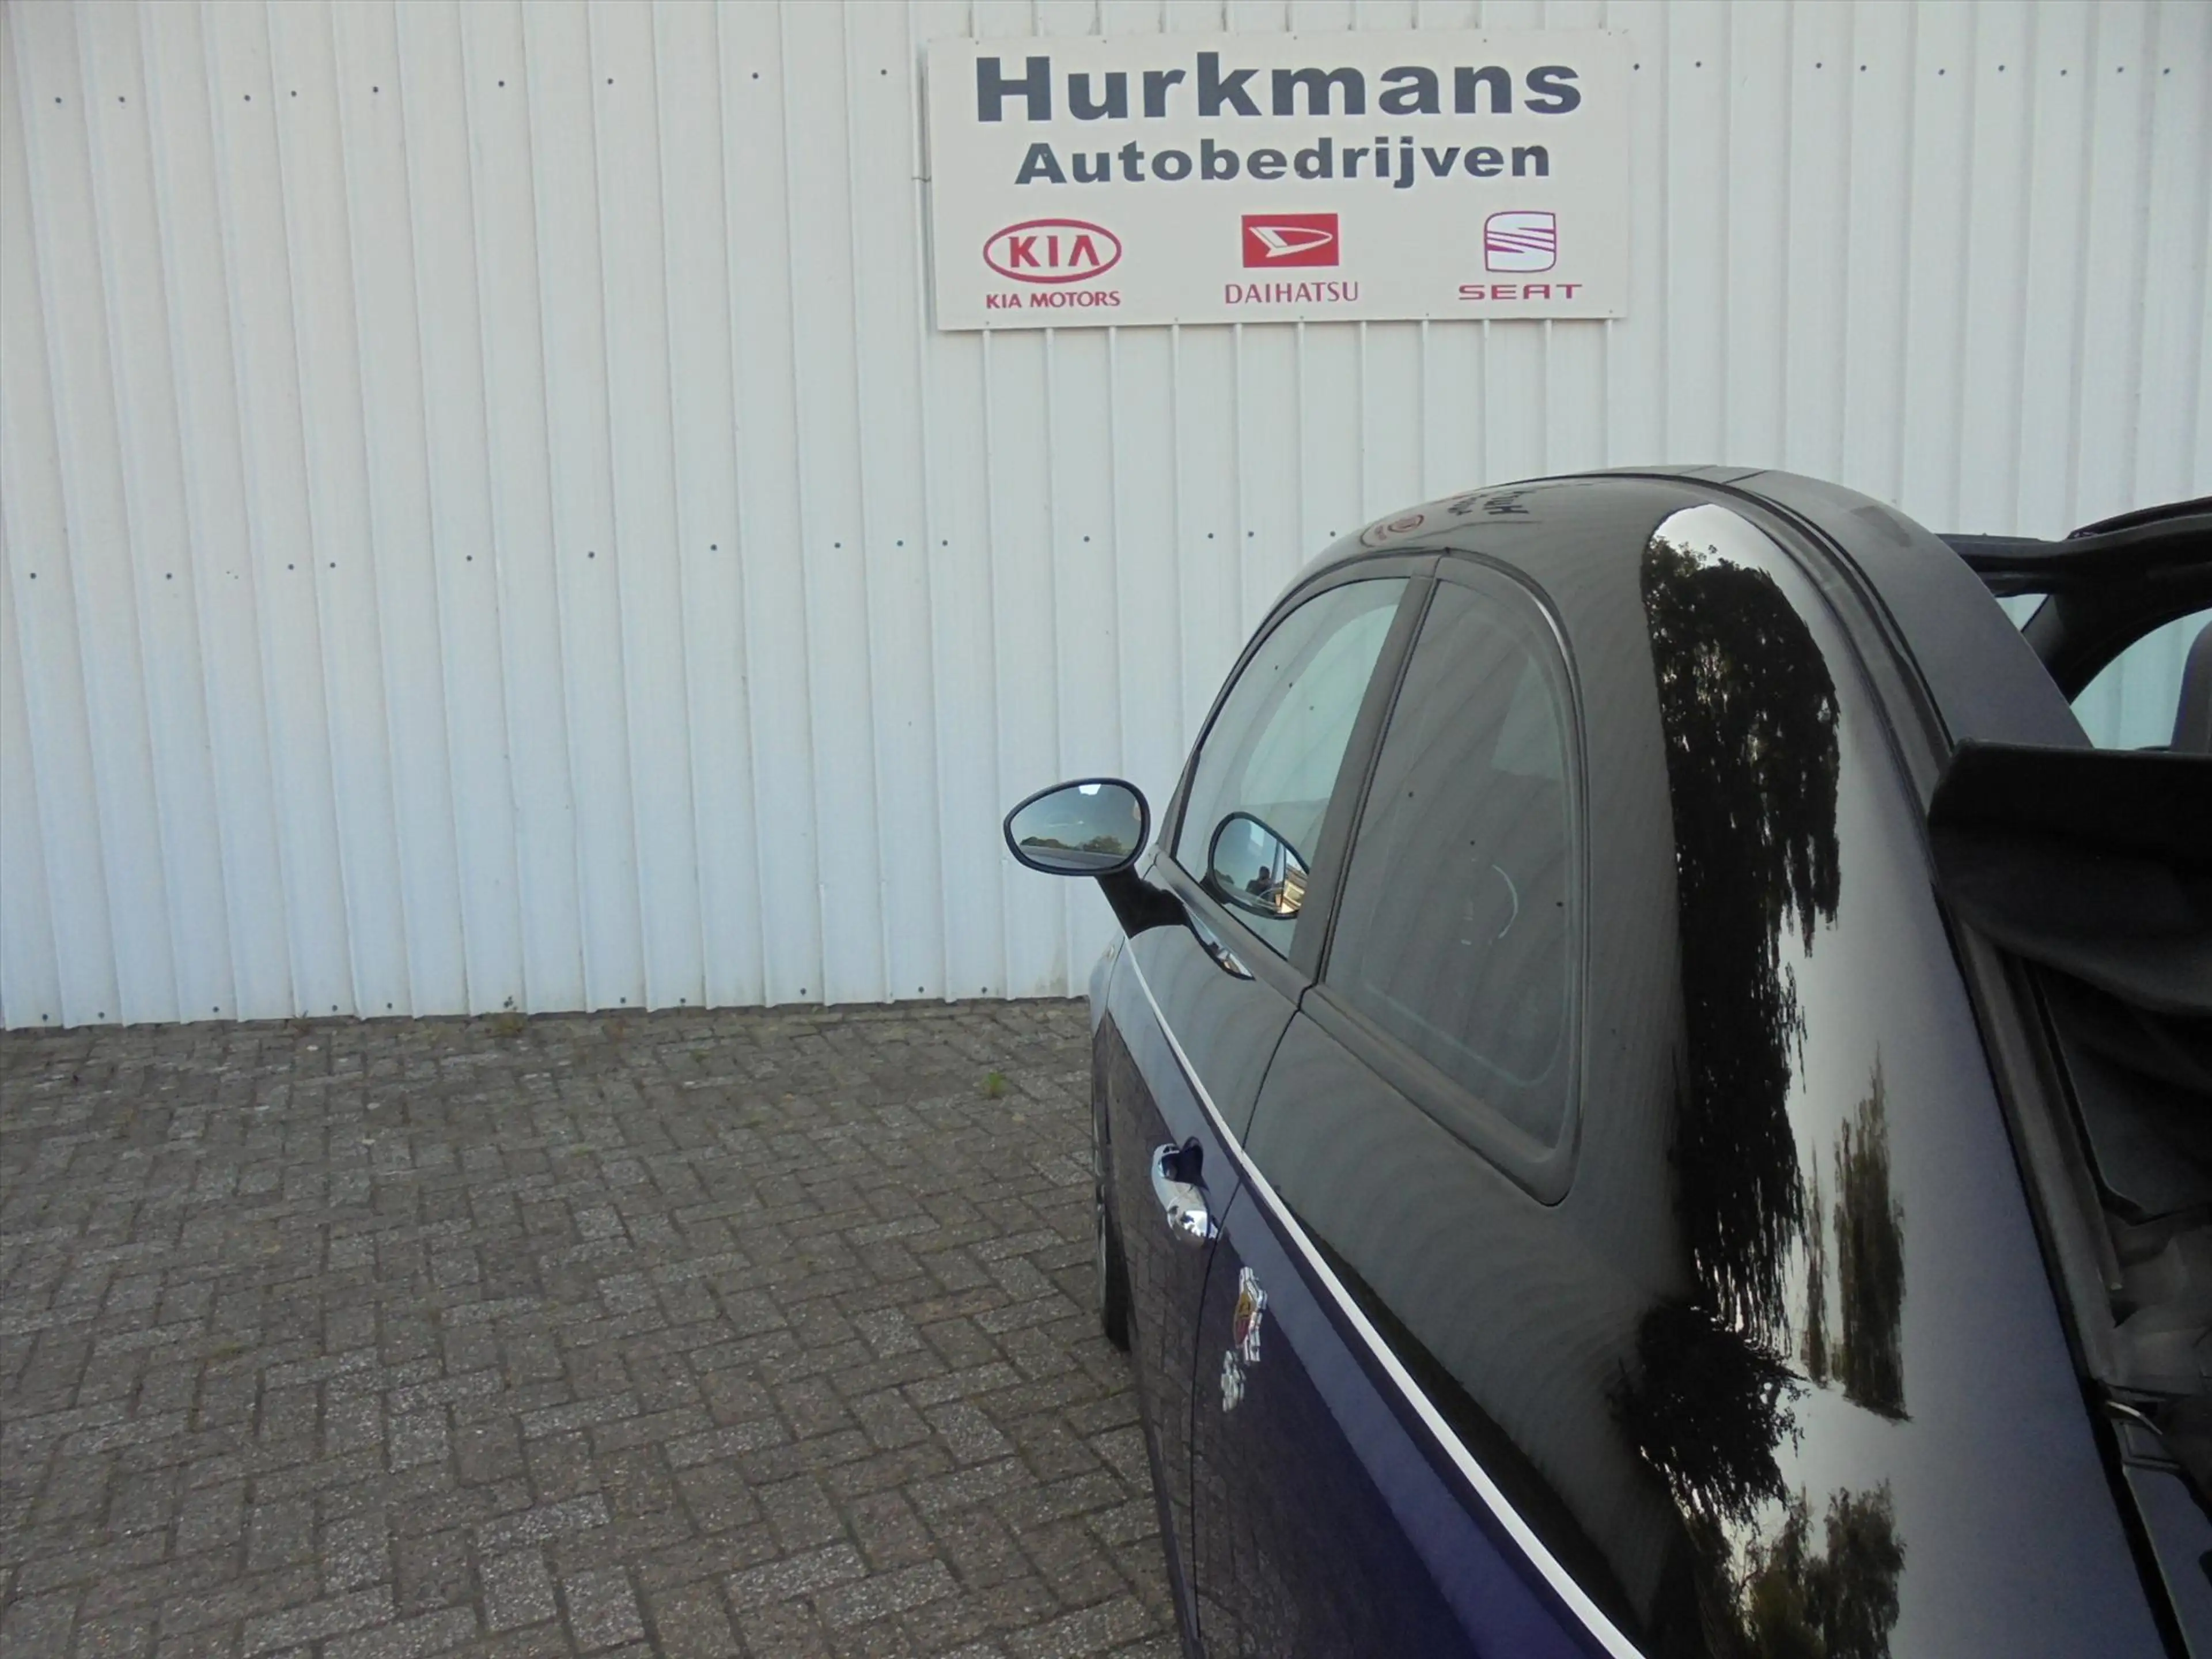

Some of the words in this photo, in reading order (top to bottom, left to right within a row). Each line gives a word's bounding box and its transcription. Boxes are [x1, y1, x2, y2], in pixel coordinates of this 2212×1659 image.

[976, 52, 1581, 122] Hurkmans
[1014, 136, 1549, 188] Autobedrijven
[1008, 235, 1100, 268] KIA
[986, 294, 1022, 309] KIA
[1030, 291, 1121, 308] MOTORS
[1225, 282, 1359, 304] DAIHATSU
[1458, 284, 1582, 300] SEAT
